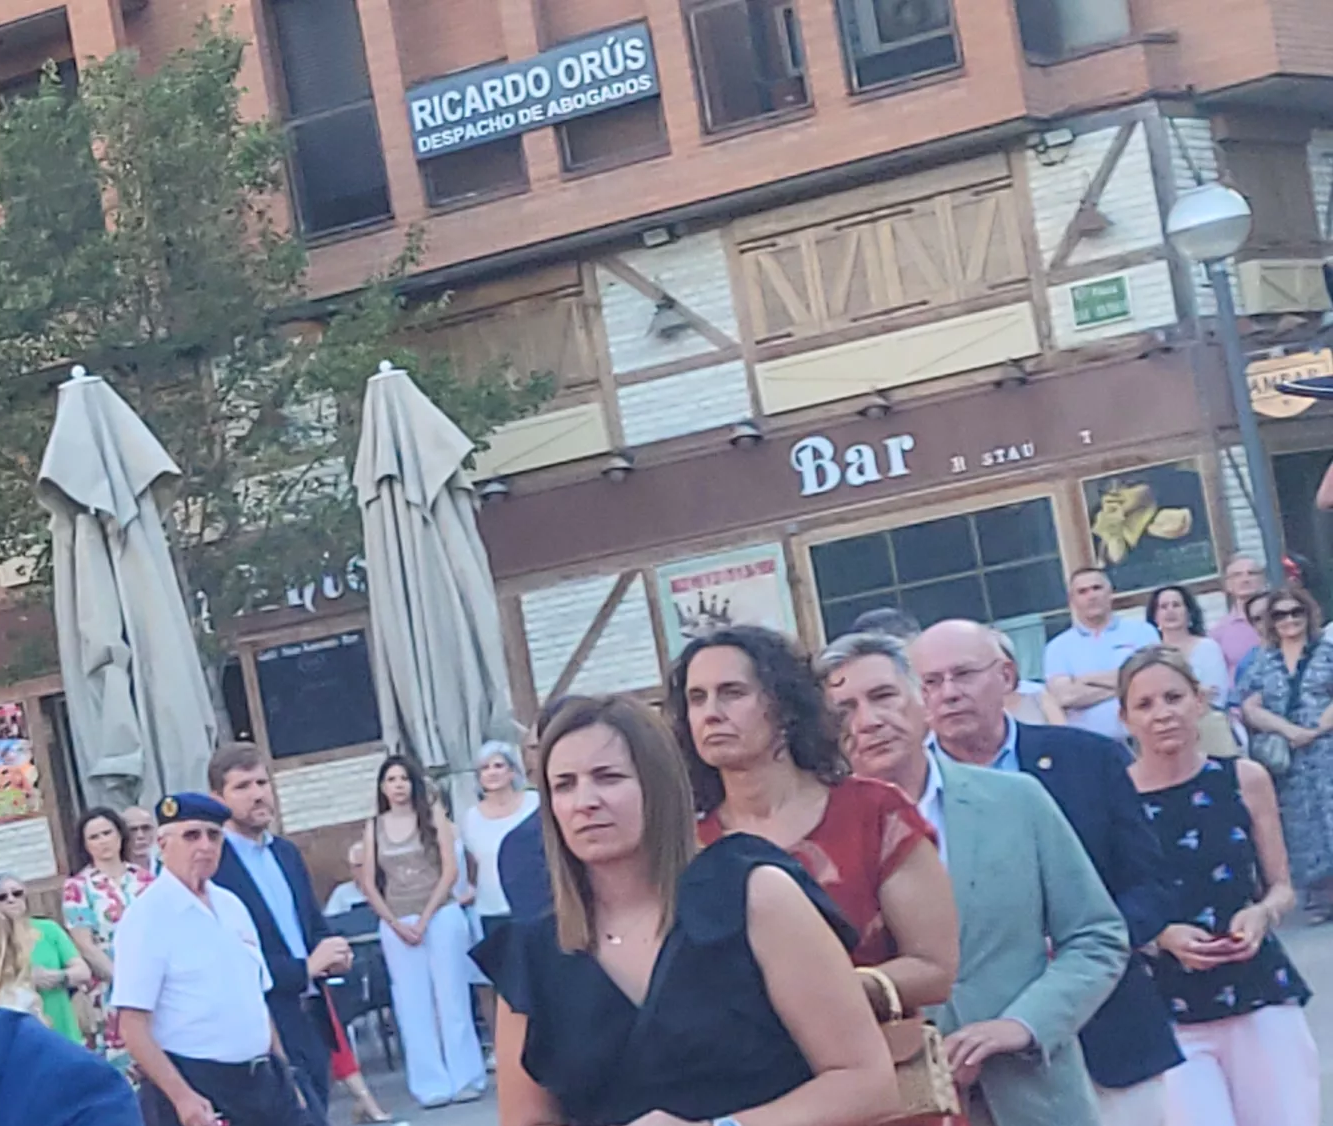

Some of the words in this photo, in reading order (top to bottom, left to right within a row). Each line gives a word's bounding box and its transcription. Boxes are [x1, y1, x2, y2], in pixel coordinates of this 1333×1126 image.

[411, 65, 552, 132] RICARDO
[558, 36, 647, 90] ORÚS
[417, 114, 517, 154] DESPACHO
[517, 104, 546, 125] DE
[547, 74, 654, 118] ABOGADOS
[789, 431, 916, 498] Bar
